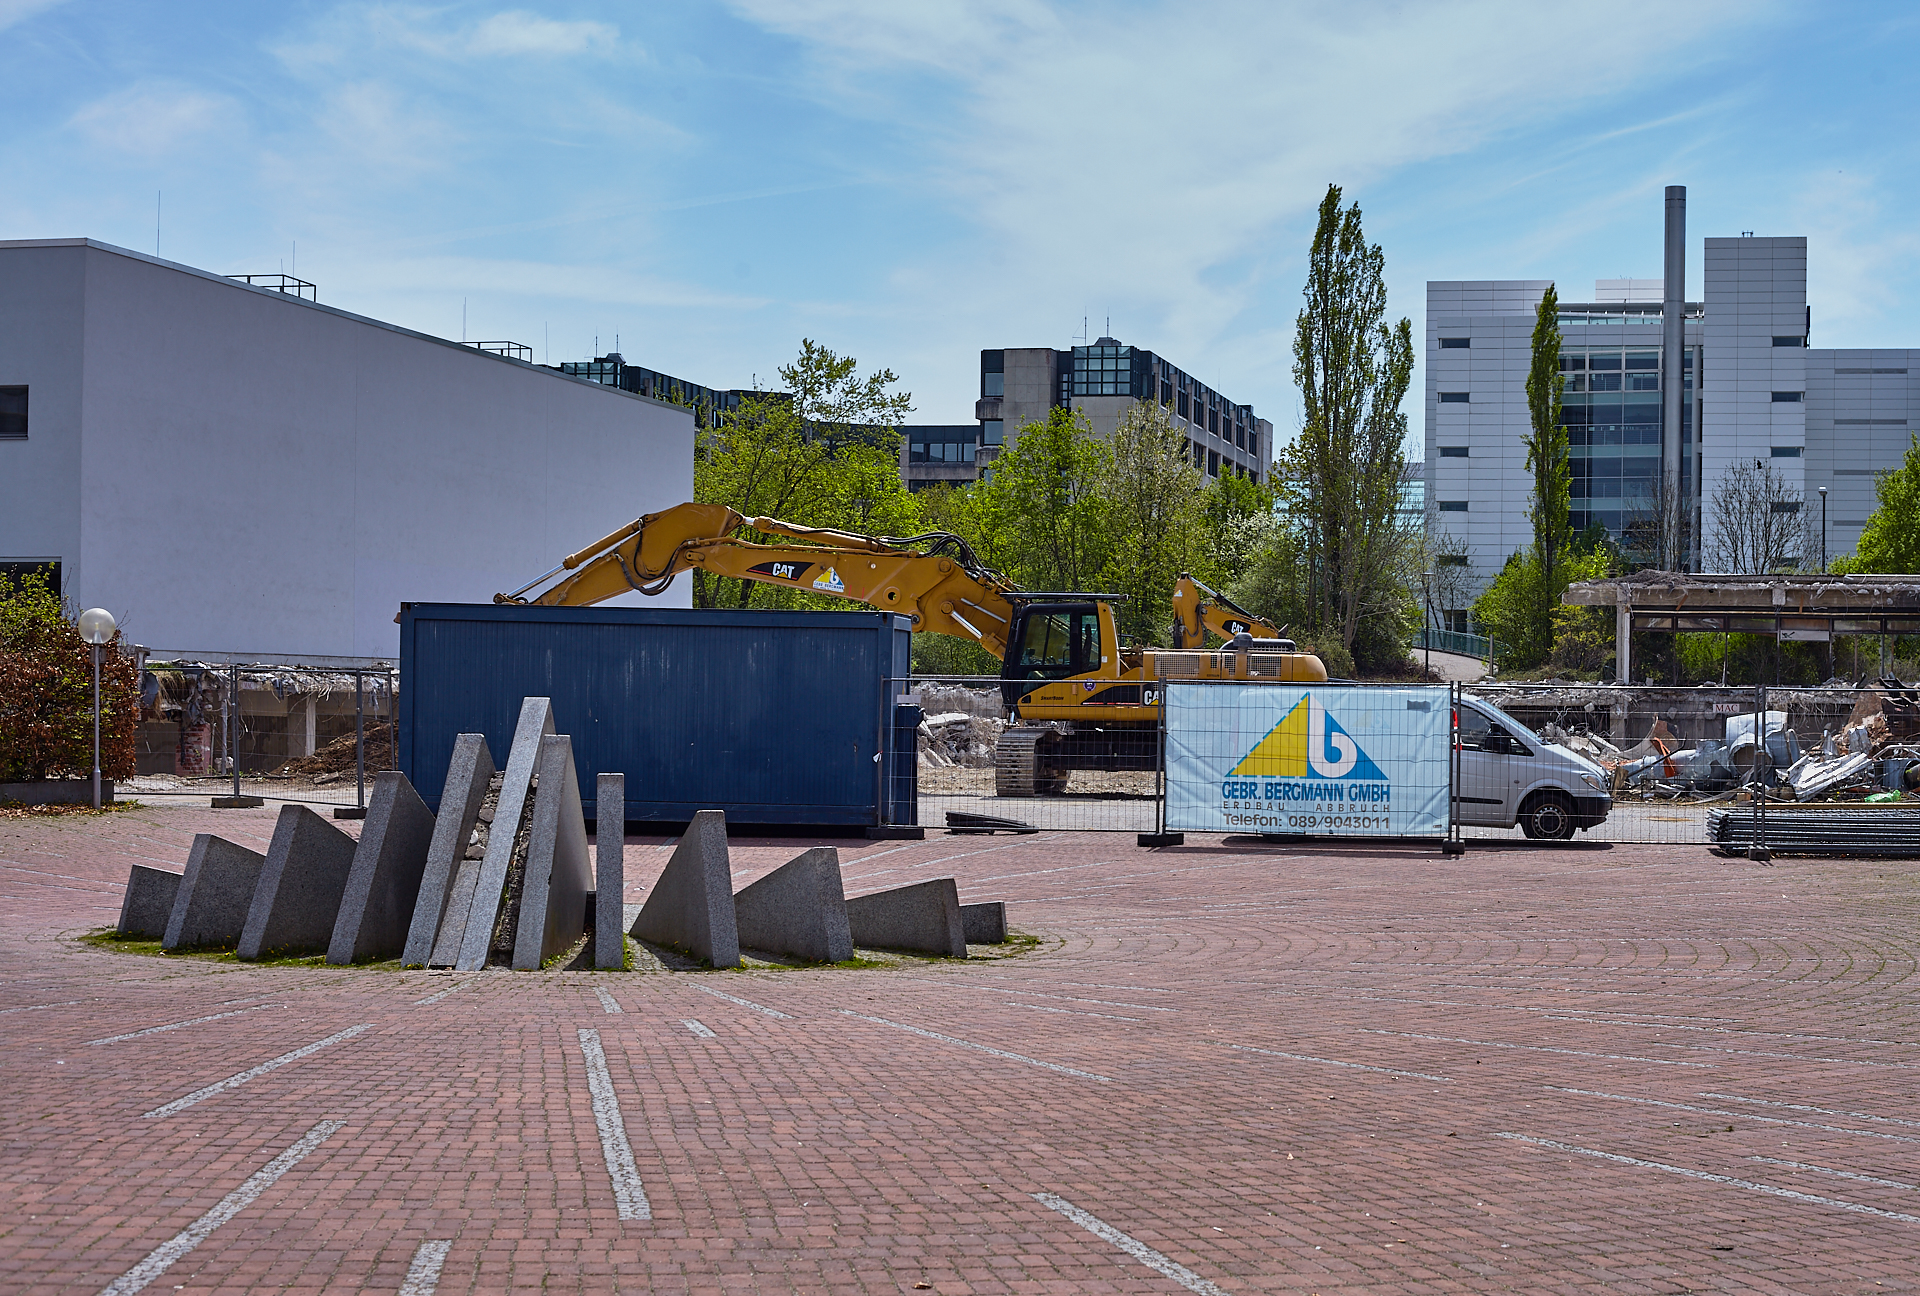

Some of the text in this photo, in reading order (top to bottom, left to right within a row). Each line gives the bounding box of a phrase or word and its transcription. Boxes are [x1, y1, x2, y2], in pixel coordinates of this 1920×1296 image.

[772, 562, 795, 579] CAT
[1230, 621, 1244, 634] CAT
[1715, 704, 1738, 712] MAC
[1222, 781, 1390, 802] GEBR. BERGMANN GMBH
[1223, 801, 1390, 813] ERDBAU ABBRUCH
[1223, 813, 1390, 829] Telefon: 089/9043011
